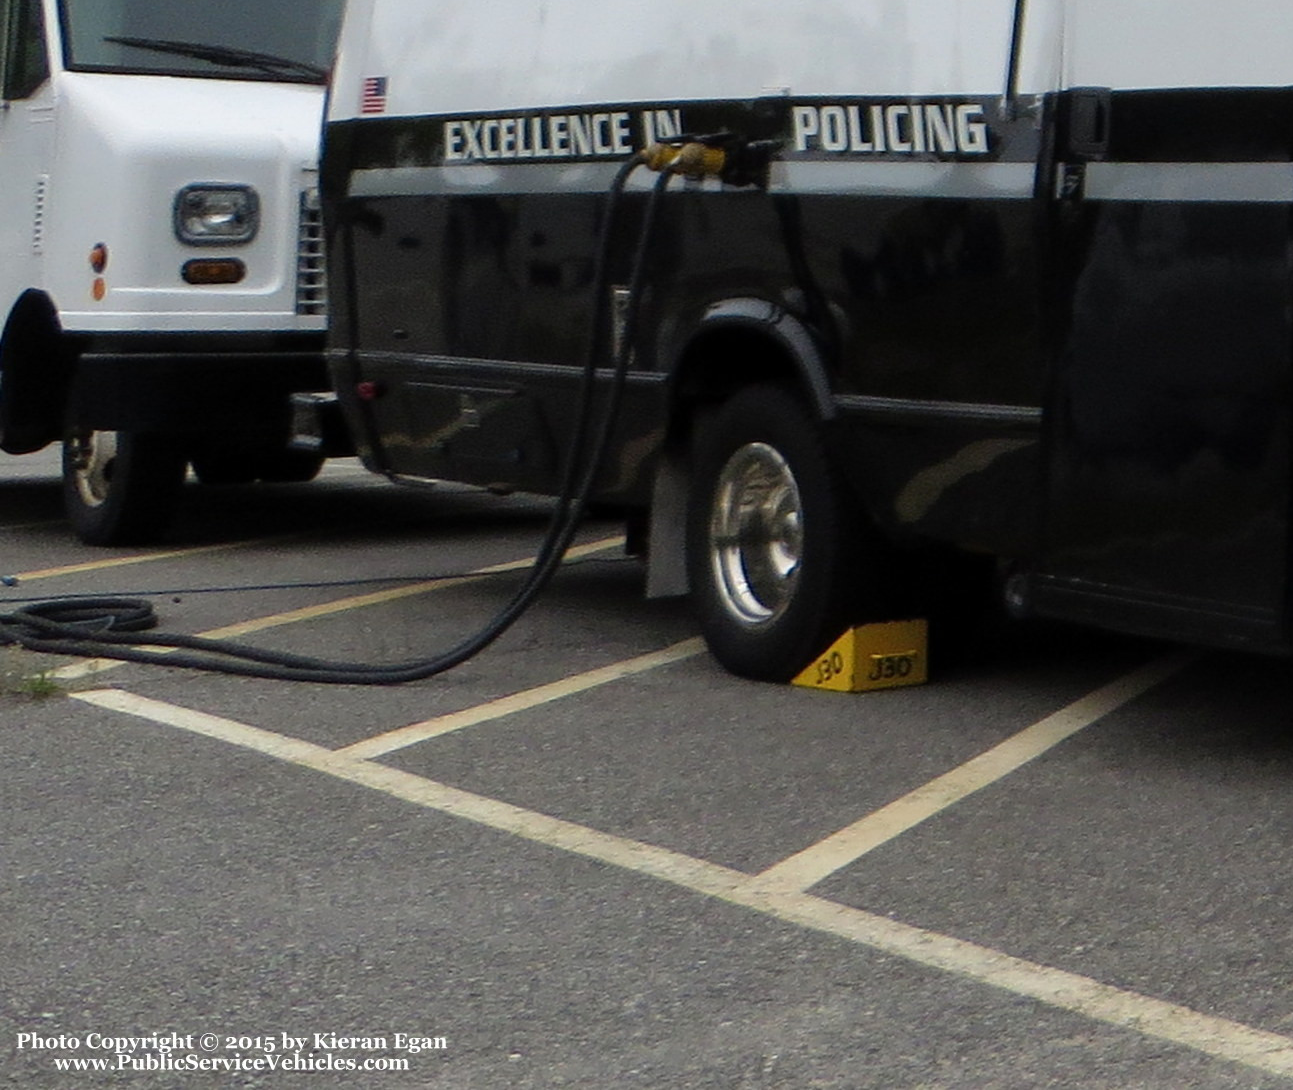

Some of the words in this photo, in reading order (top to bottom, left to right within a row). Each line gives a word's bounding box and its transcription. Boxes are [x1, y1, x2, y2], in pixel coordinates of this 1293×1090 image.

[444, 110, 633, 160] EXCELLENCE
[642, 109, 683, 150] IN
[794, 104, 990, 156] POLICING
